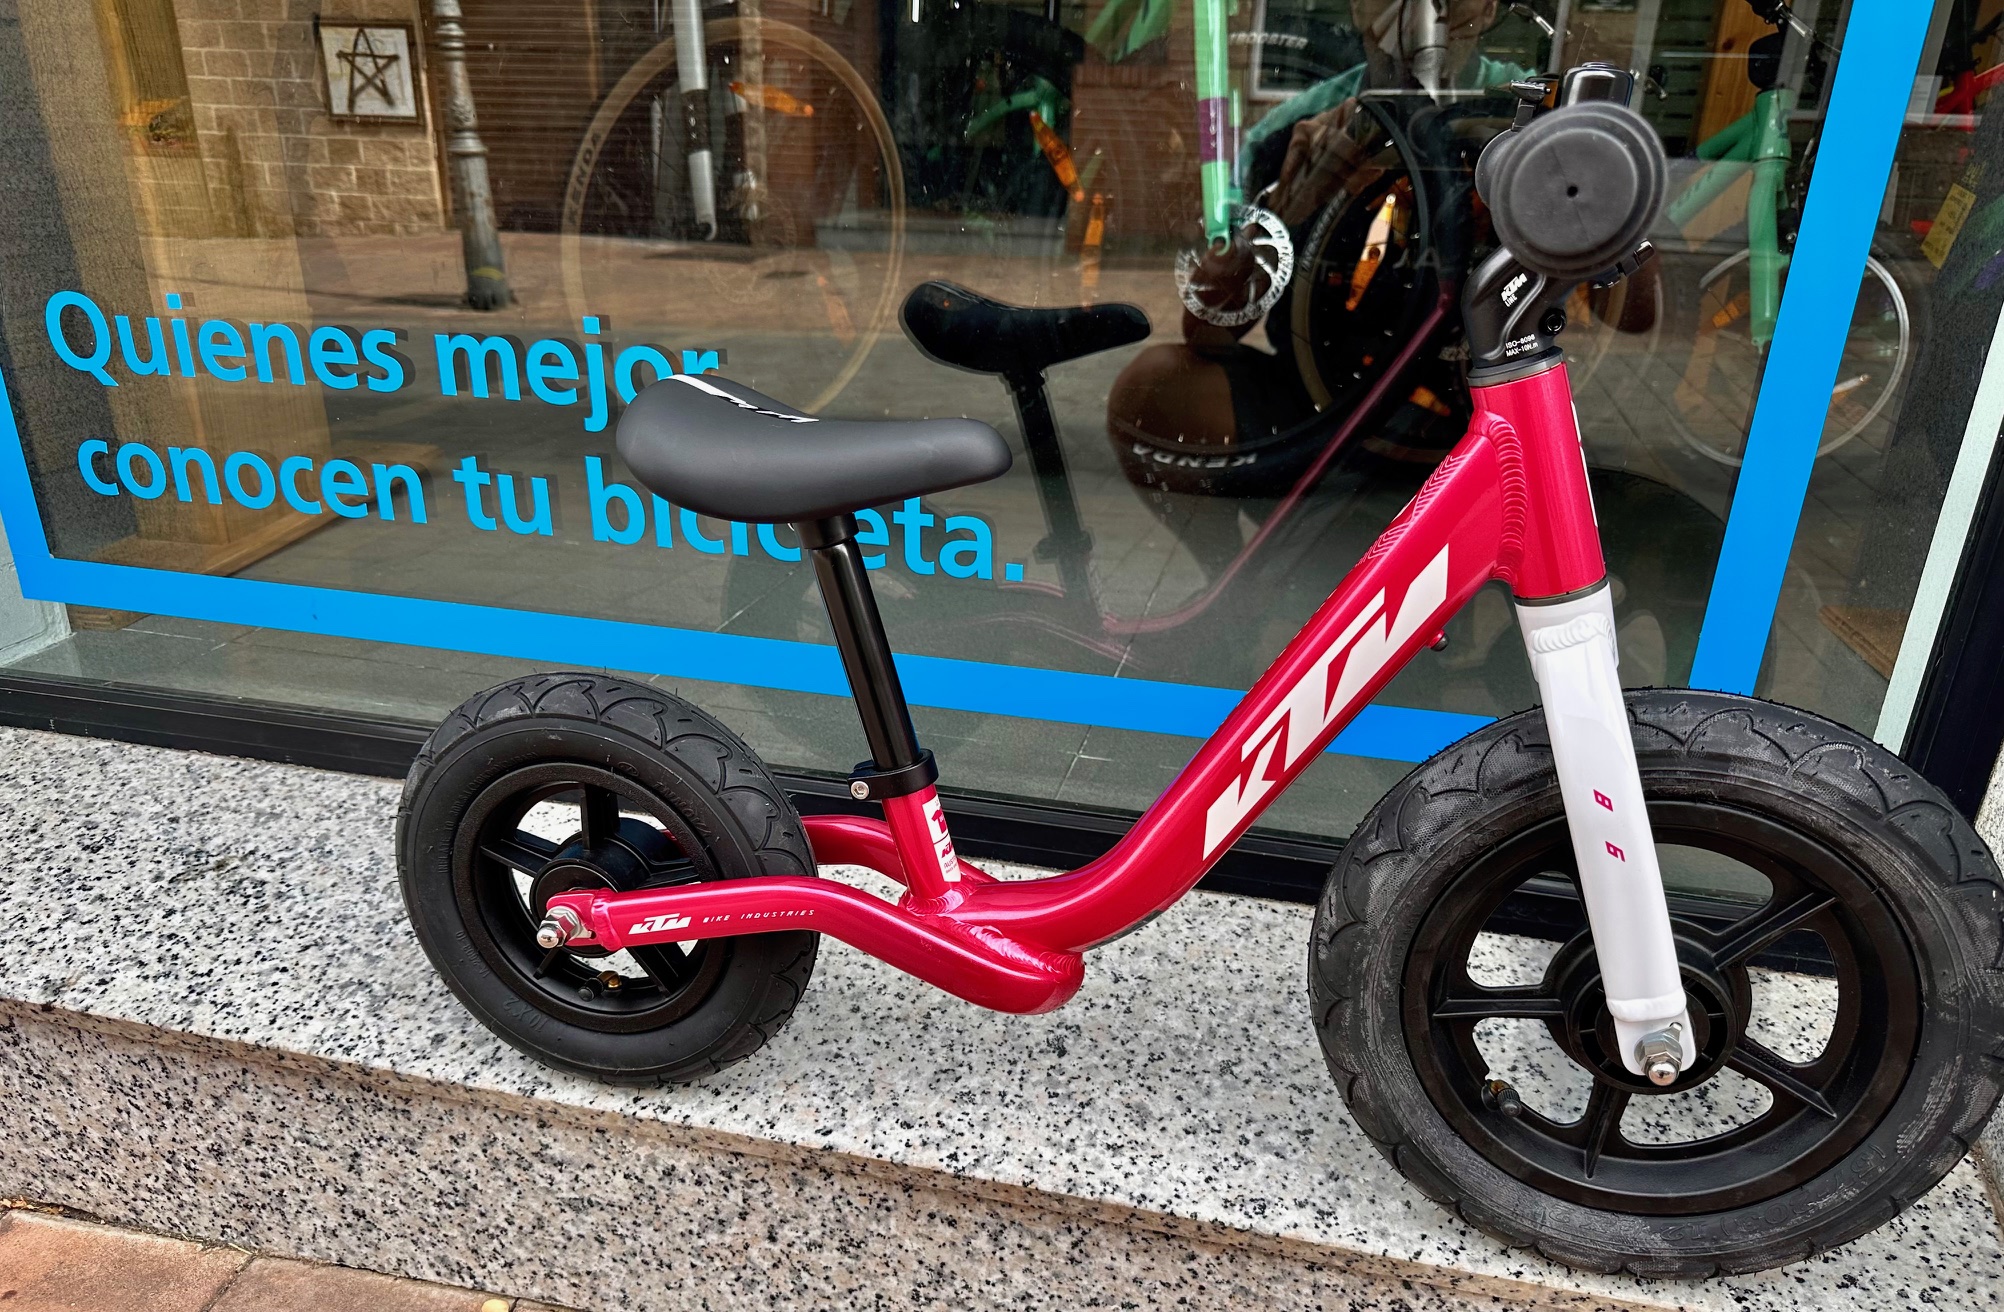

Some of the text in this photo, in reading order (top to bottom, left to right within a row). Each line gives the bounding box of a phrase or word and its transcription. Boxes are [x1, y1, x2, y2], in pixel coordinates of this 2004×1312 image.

[1501, 273, 1528, 302] KTM
[1504, 293, 1518, 307] LINE
[46, 291, 719, 432] Quienes mejor
[1132, 443, 1258, 468] KENDA
[78, 440, 1024, 582] conocen tu bicceta.
[1203, 543, 1449, 861] KTM
[628, 909, 816, 935] KTM BIKE INDUSTRIES
